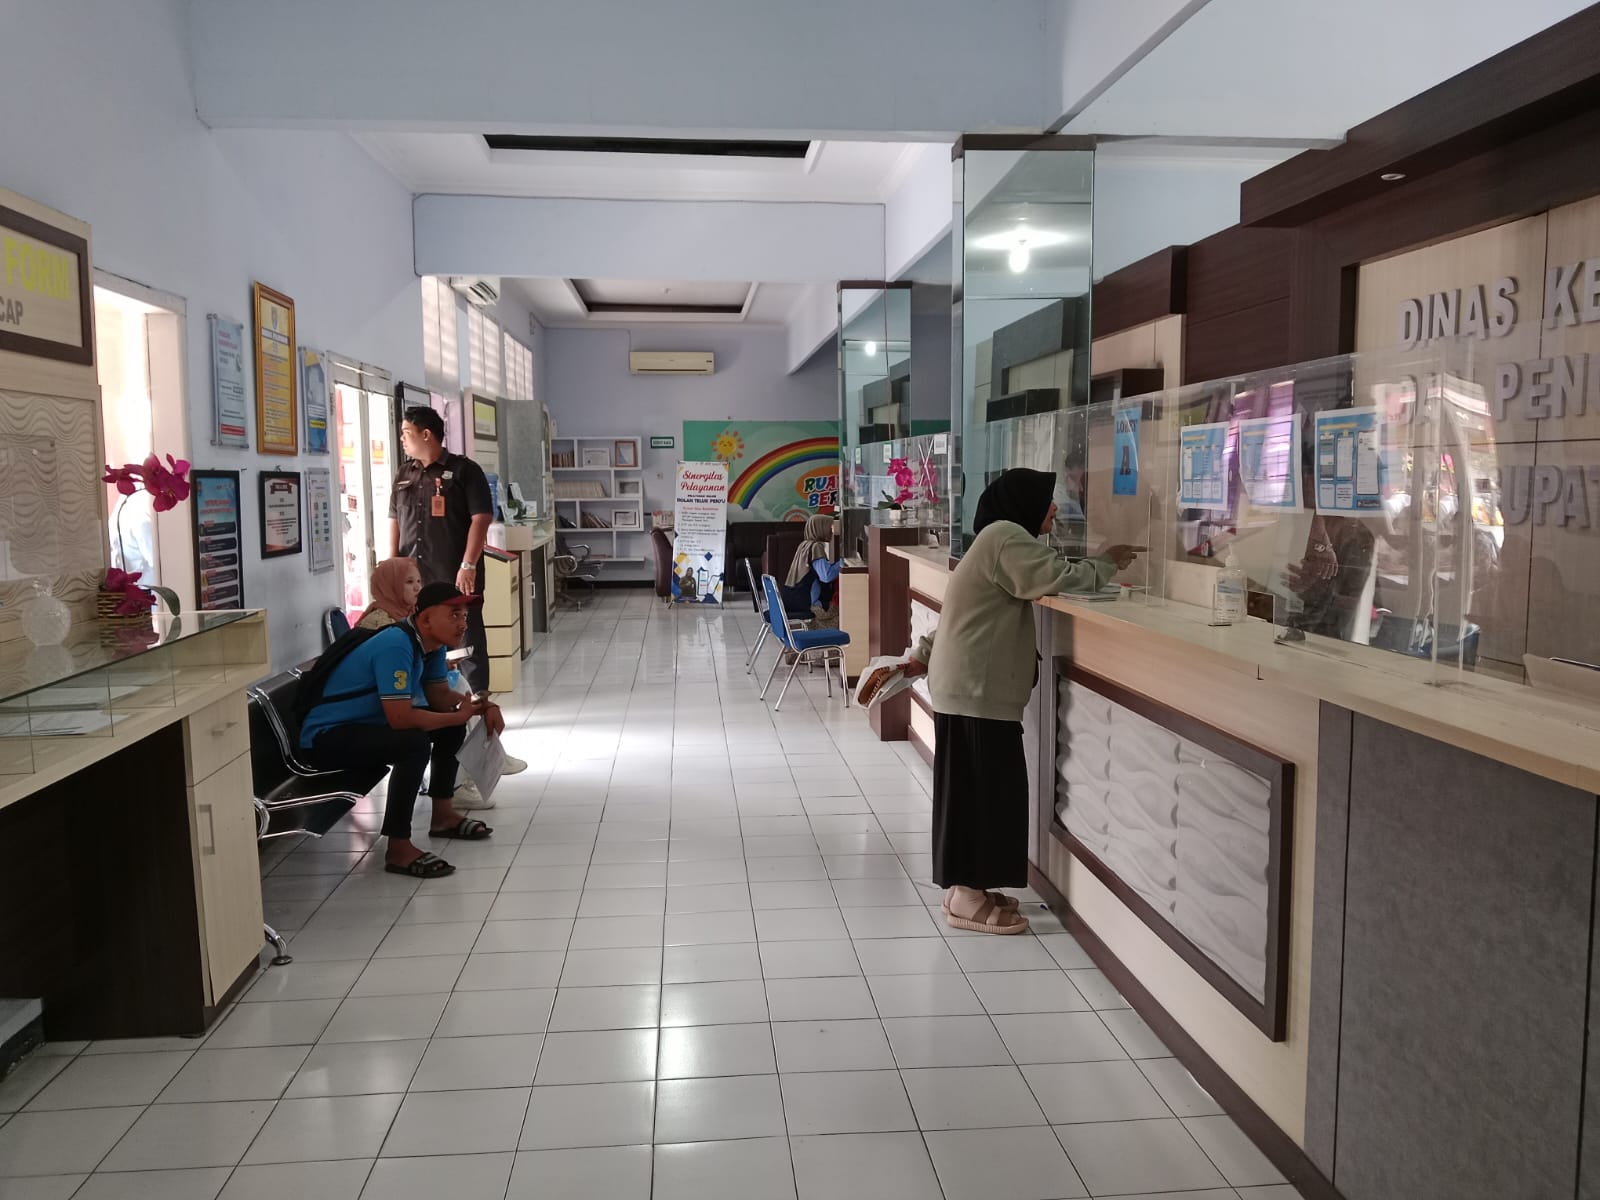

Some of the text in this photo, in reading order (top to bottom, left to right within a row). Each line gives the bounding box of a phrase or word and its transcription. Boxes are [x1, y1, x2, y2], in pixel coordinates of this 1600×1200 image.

[4, 236, 70, 301] FORM
[1399, 277, 1518, 351] DINAS
[681, 481, 725, 493] Pelayanan
[804, 475, 839, 493] RUA
[394, 671, 407, 690] 3
